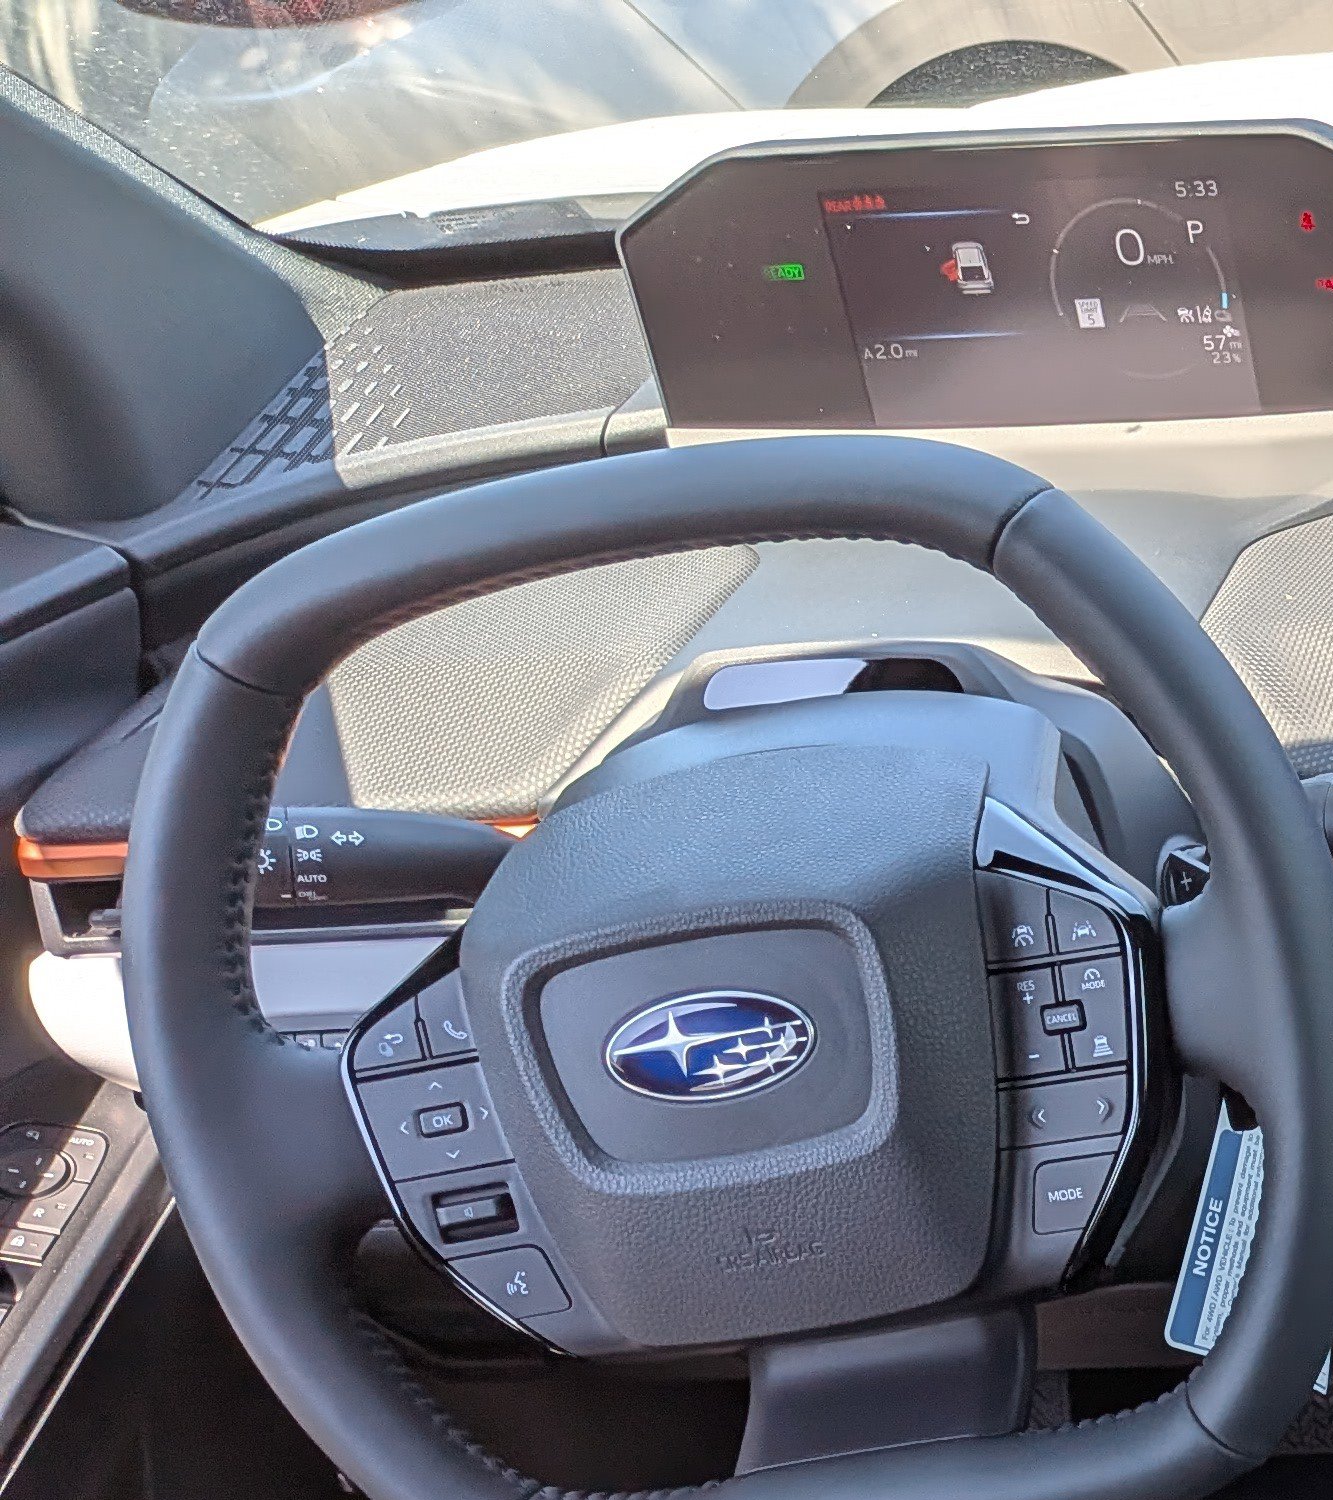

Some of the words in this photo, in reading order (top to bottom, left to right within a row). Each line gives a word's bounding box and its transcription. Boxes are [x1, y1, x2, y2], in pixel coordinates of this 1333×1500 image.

[1174, 180, 1218, 197] 5:33
[1186, 220, 1204, 244] P
[1115, 228, 1145, 266] 0
[1147, 254, 1174, 265] MPH
[764, 265, 802, 280] EADY
[1087, 313, 1096, 325] 5
[1203, 334, 1226, 351] 57
[874, 343, 903, 360] 2.0
[1211, 352, 1242, 364] 23%
[297, 874, 327, 883] AUTO
[1017, 980, 1035, 991] RES
[1081, 979, 1105, 990] MODE
[1046, 1012, 1077, 1025] CANCEL
[432, 1114, 454, 1128] OK
[69, 1137, 95, 1147] AUTO
[1048, 1187, 1084, 1203] MODE
[33, 1207, 45, 1218] R
[1192, 1197, 1223, 1277] NOTICE
